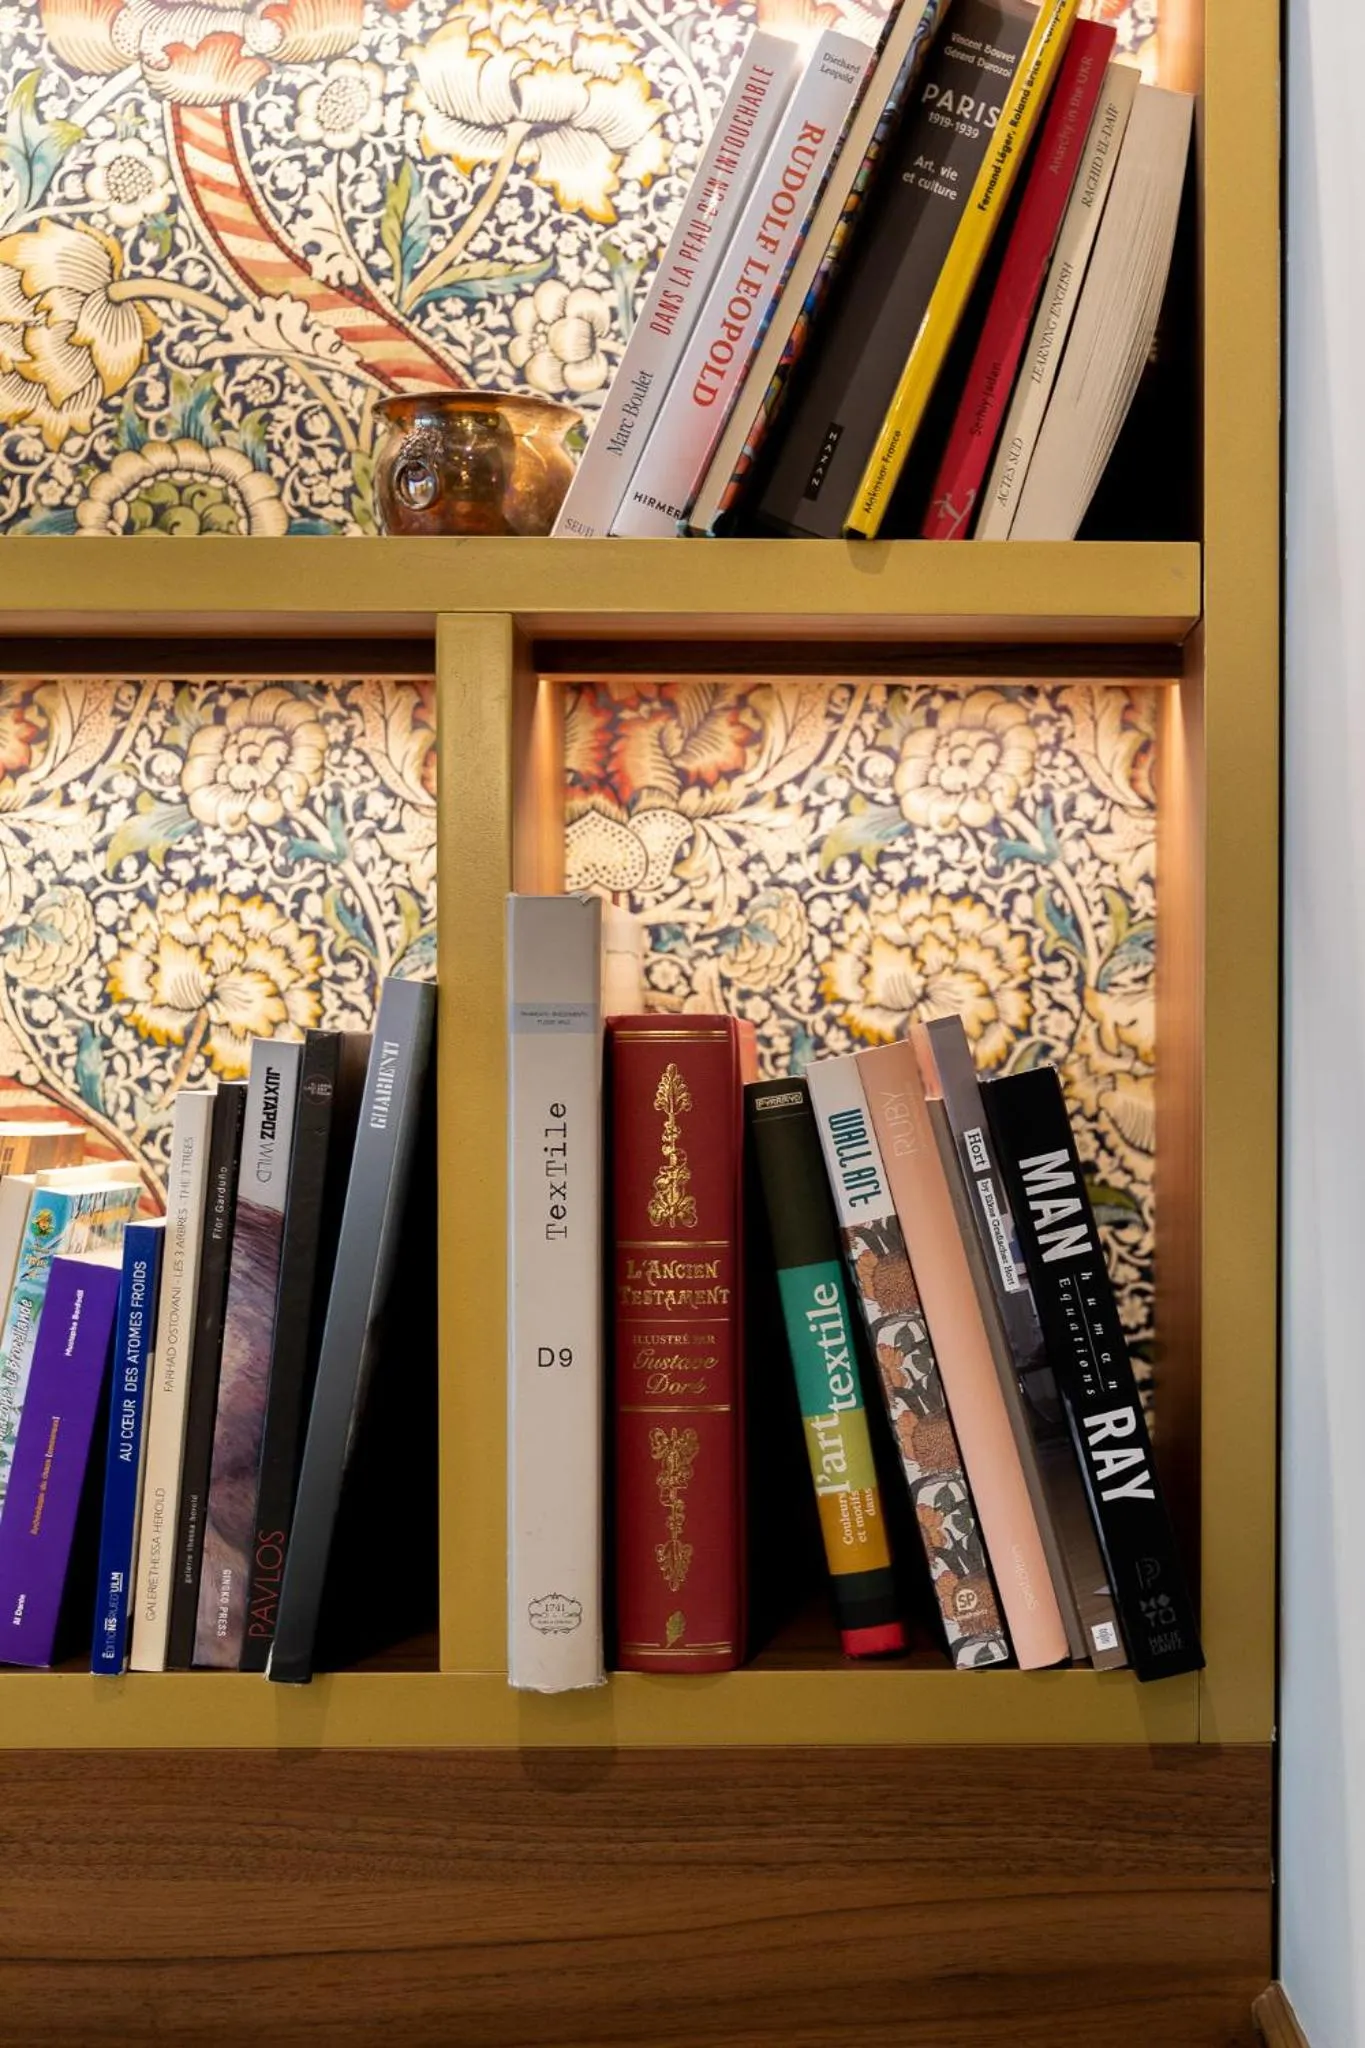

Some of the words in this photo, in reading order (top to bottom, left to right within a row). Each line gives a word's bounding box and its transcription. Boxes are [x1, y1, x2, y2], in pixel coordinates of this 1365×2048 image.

[1078, 55, 1095, 85] UKR
[713, 64, 774, 175] INTOUCHABLE
[922, 83, 1001, 129] PARIS
[1067, 106, 1079, 121] in
[1070, 86, 1085, 108] the
[928, 111, 980, 139] 1919-1939
[978, 166, 1003, 212] Fernand
[995, 130, 1017, 164] Léger,
[1009, 88, 1031, 128] Roland
[1050, 123, 1076, 175] Anarchy
[756, 120, 827, 255] RUDOLF
[902, 171, 915, 185] et
[918, 177, 959, 201] culture
[940, 166, 959, 183] vie
[1081, 157, 1104, 209] RACHID
[679, 219, 712, 263] PEAU
[668, 265, 695, 288] LA
[650, 289, 685, 337] DANS
[692, 255, 771, 408] LEOPOLD
[1031, 318, 1057, 384] LEARNING
[1050, 261, 1075, 319] ENGLISH
[606, 418, 636, 457] Marc
[622, 369, 654, 419] Boulet
[997, 467, 1016, 508] ACTES
[1007, 436, 1025, 467] SUD
[633, 491, 685, 521] HIRMER
[260, 1066, 281, 1140] JUXTAPOZ
[879, 1091, 920, 1157] RUBY
[183, 1136, 195, 1167] TREES
[828, 1108, 872, 1168] WALL
[967, 1131, 987, 1167] Hort
[255, 1141, 275, 1184] WILD
[543, 1101, 569, 1241] TexTile
[180, 1176, 192, 1201] THE
[1018, 1148, 1093, 1263] MAN
[177, 1207, 189, 1252] ARBRES
[979, 1180, 990, 1194] by
[1003, 1263, 1016, 1286] Hort
[131, 1260, 147, 1308] FROIDS
[173, 1260, 185, 1279] LES
[126, 1311, 143, 1365] ATOMES
[167, 1288, 183, 1345] OSTOVANI
[633, 1333, 690, 1345] ILLUSTRÉ
[1058, 1276, 1096, 1398] Equations
[1080, 1271, 1118, 1390] human
[164, 1343, 177, 1394] FARHAD
[537, 1347, 573, 1368] D9
[633, 1349, 720, 1370] Gustave
[806, 1282, 858, 1418] textile
[124, 1366, 138, 1393] DES
[645, 1372, 707, 1395] Doré
[120, 1398, 137, 1439] CŒUR
[119, 1441, 133, 1463] AU
[1083, 1405, 1156, 1502] RAY
[152, 1487, 166, 1535] HEROLD
[849, 1490, 865, 1528] motifs
[864, 1487, 876, 1517] dans
[857, 1530, 867, 1543] et
[249, 1529, 286, 1638] PAVLOS
[956, 1592, 978, 1609] SP
[216, 1606, 230, 1638] PRESS
